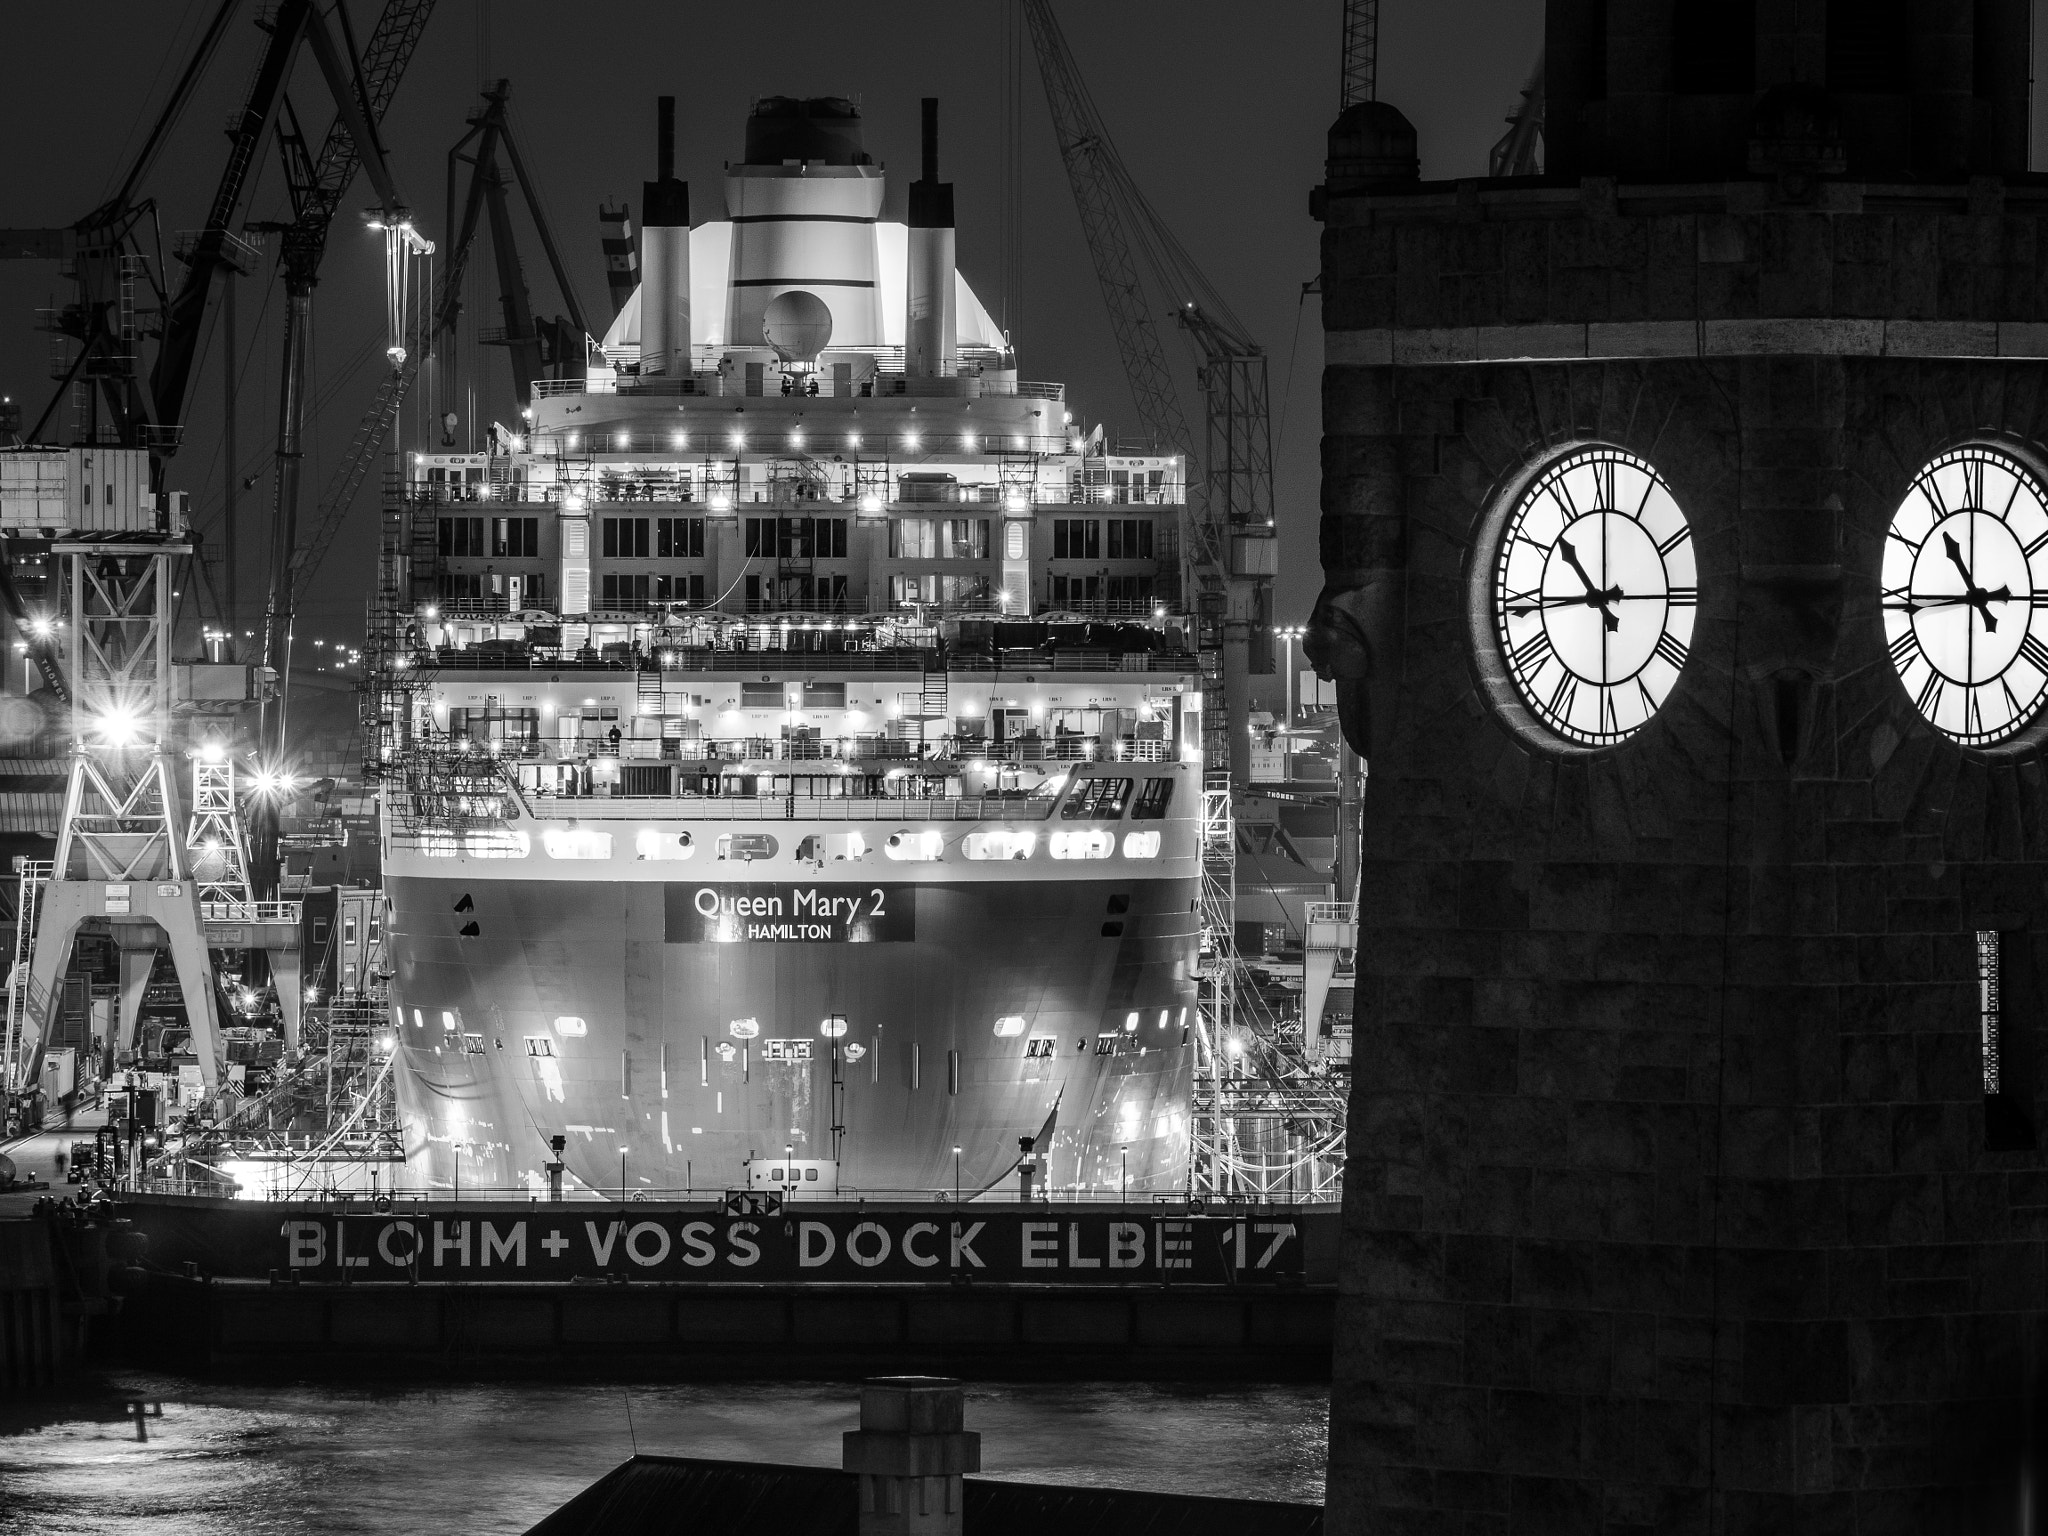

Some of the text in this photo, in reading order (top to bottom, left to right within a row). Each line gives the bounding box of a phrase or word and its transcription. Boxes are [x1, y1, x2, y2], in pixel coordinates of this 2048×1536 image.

[694, 888, 886, 925] Queen Mary 2
[748, 924, 832, 939] HAMILTON
[799, 1220, 987, 1268] DOCK
[1022, 1221, 1192, 1268] ELBE
[1223, 1221, 1297, 1269] 17
